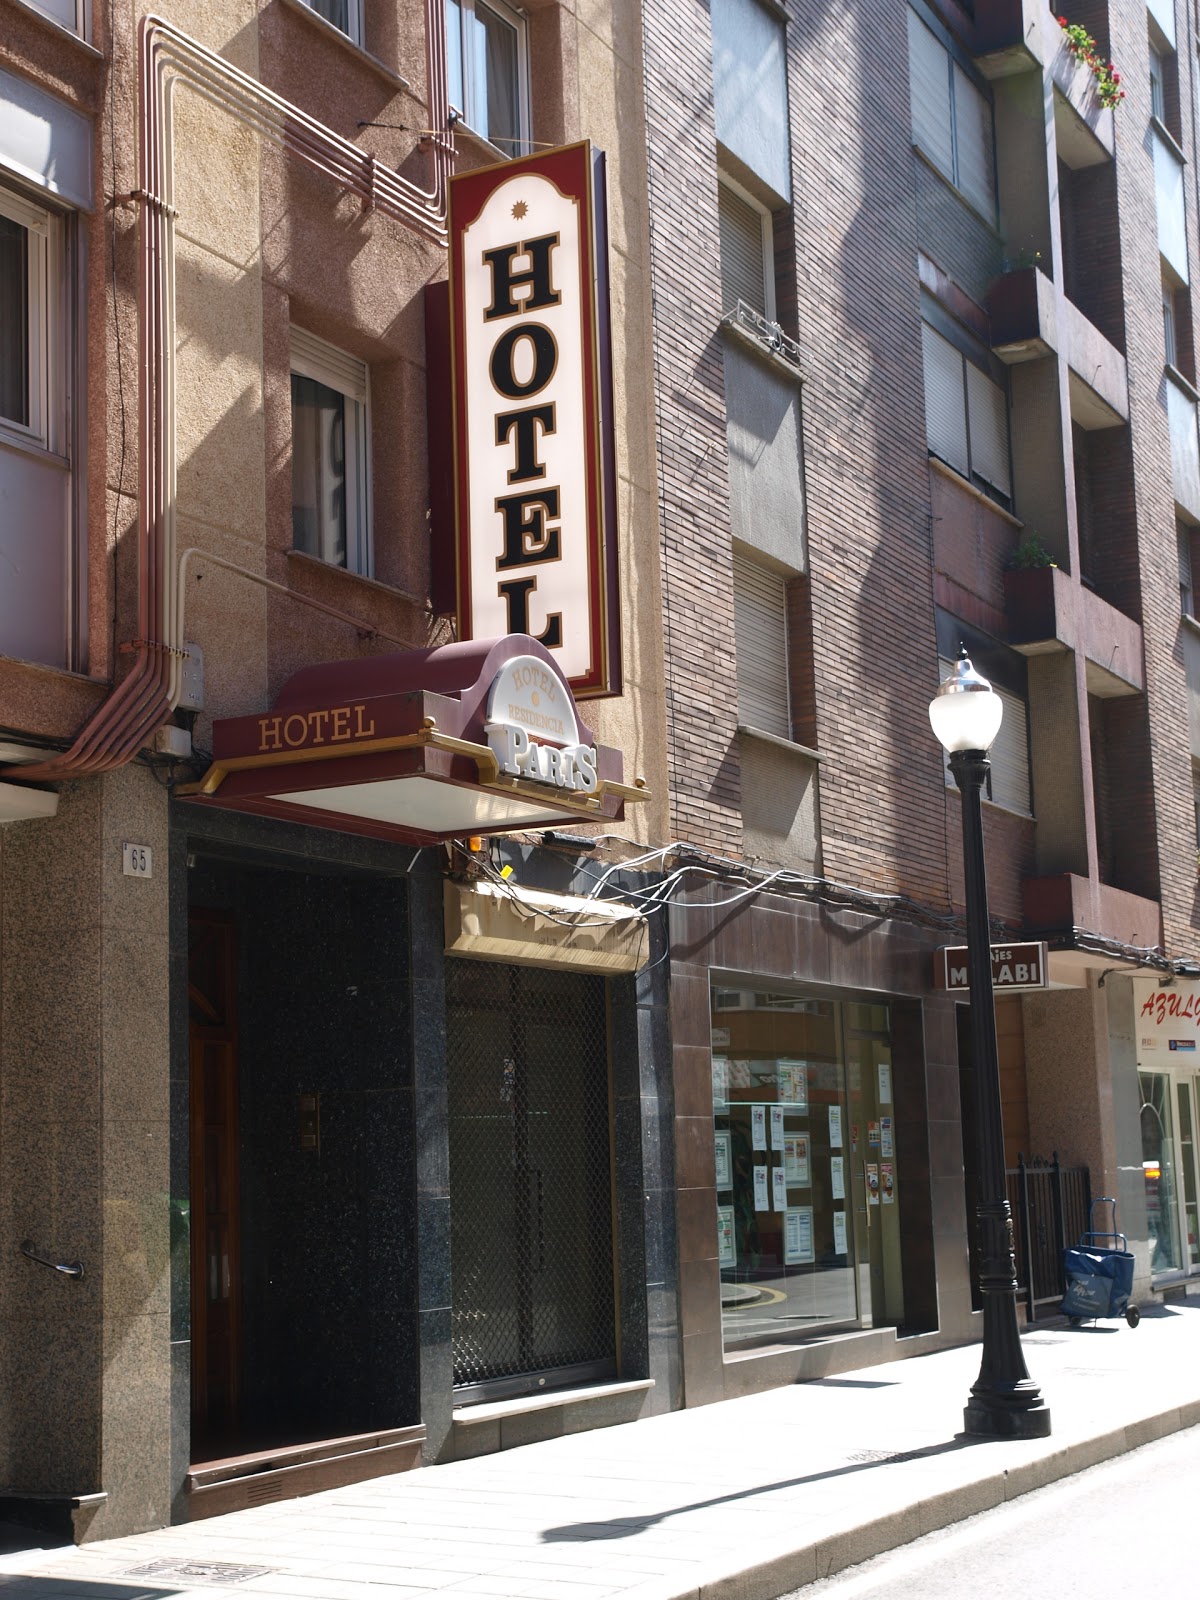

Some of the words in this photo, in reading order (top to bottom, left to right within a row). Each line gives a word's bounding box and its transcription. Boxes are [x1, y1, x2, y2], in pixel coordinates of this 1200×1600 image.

[482, 231, 563, 650] HOTEL
[512, 666, 556, 702] HOTEL
[258, 705, 375, 751] HOTEL
[507, 703, 564, 735] RESIDENCIA
[131, 849, 147, 872] 65
[950, 962, 1038, 985] MABI
